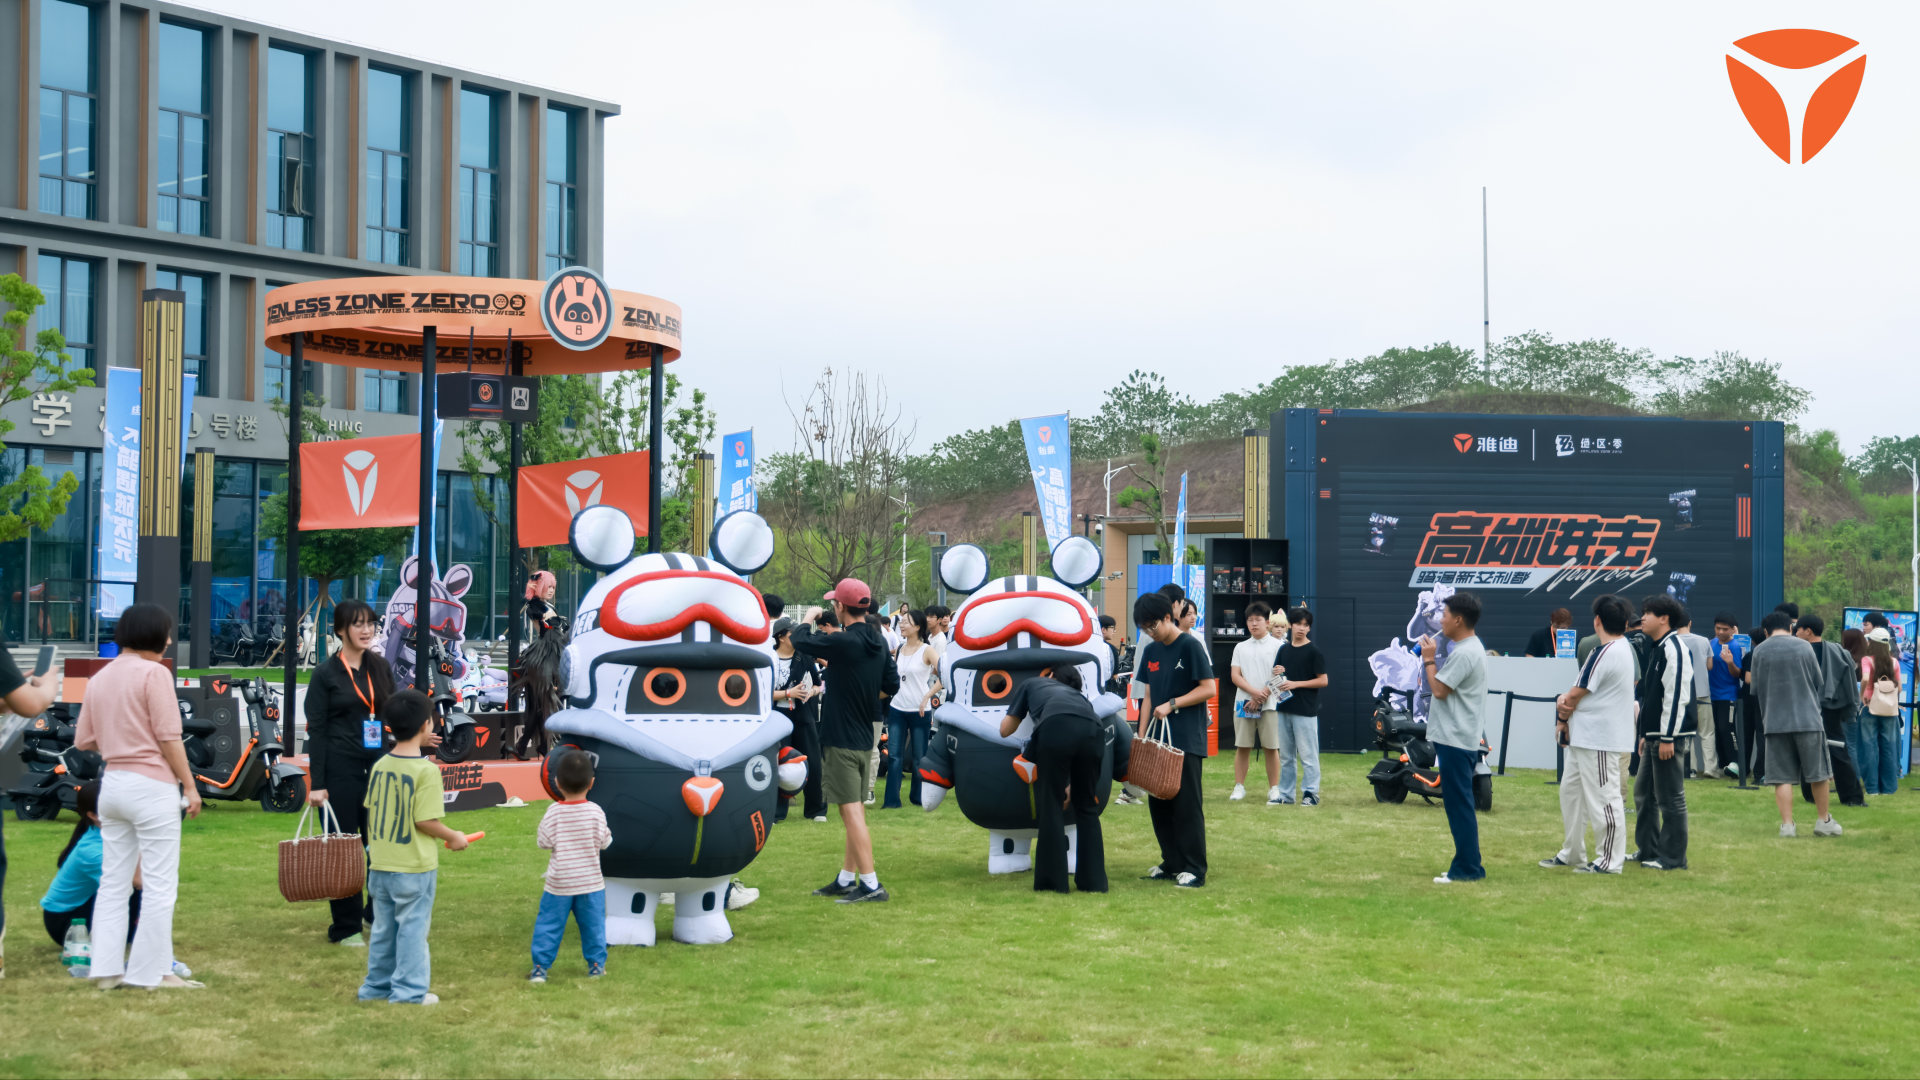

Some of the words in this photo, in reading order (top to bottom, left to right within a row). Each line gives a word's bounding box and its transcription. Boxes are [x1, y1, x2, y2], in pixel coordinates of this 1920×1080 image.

[267, 296, 331, 322] ZENLESS
[336, 292, 405, 311] ZONE
[411, 292, 492, 310] ZERO
[436, 345, 502, 360] ZERO
[1476, 436, 1519, 453] 雅迪
